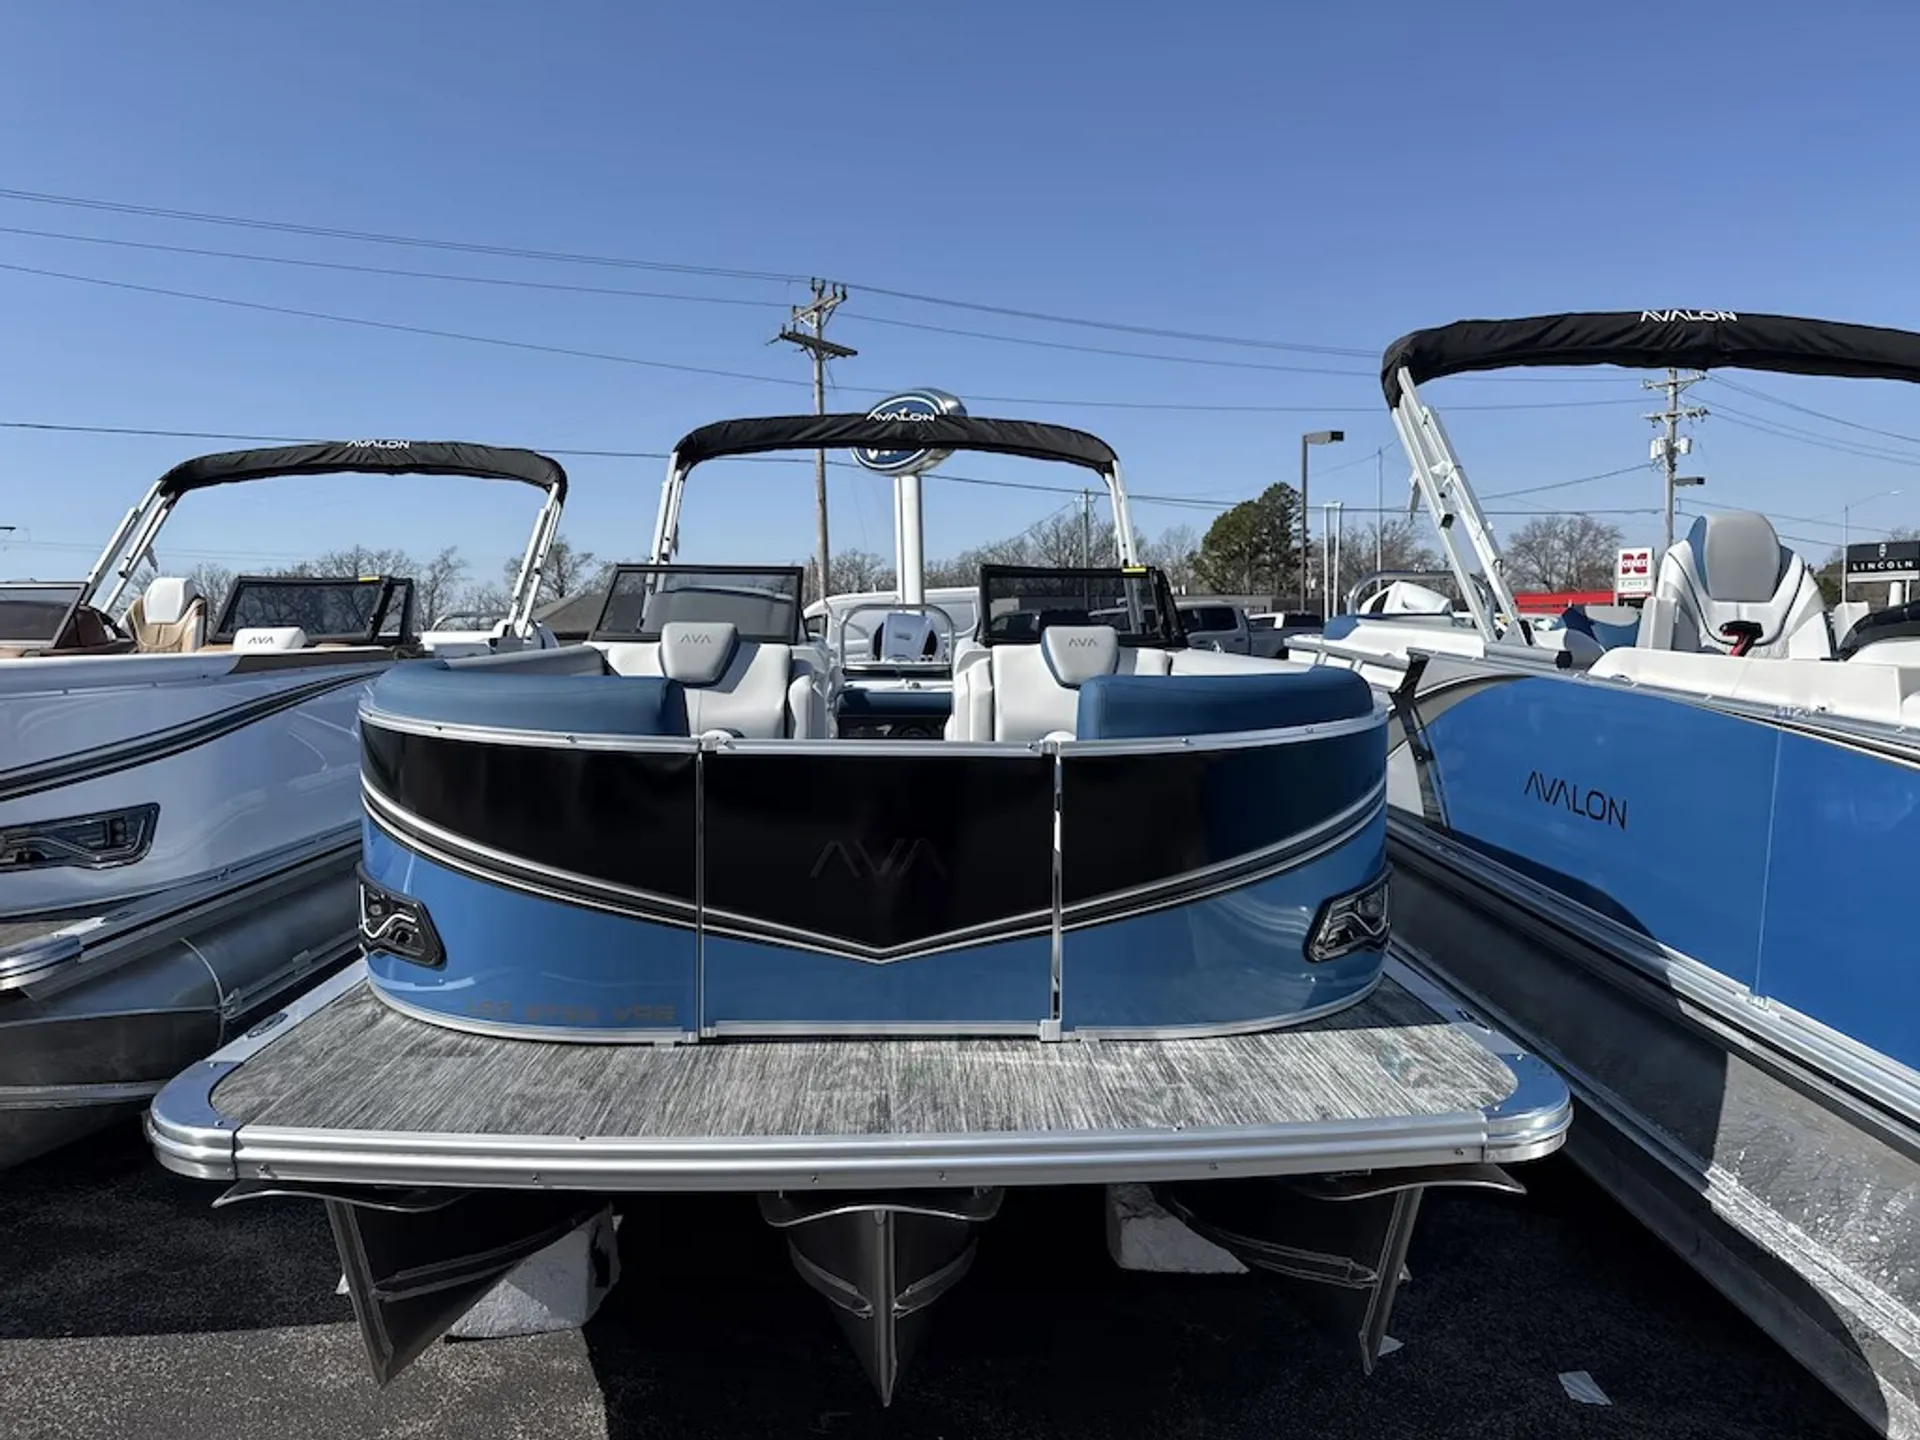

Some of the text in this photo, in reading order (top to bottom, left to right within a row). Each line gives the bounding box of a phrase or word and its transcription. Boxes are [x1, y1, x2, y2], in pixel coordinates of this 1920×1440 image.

[1640, 309, 1738, 322] AVALON
[866, 412, 935, 422] AVALON
[346, 439, 411, 450] AVALON
[1852, 560, 1914, 572] LINCOLN
[247, 636, 275, 645] AVA
[680, 633, 712, 645] AVA
[1068, 637, 1098, 647] AVA
[1524, 769, 1628, 831] AVALON
[809, 837, 948, 879] AVA
